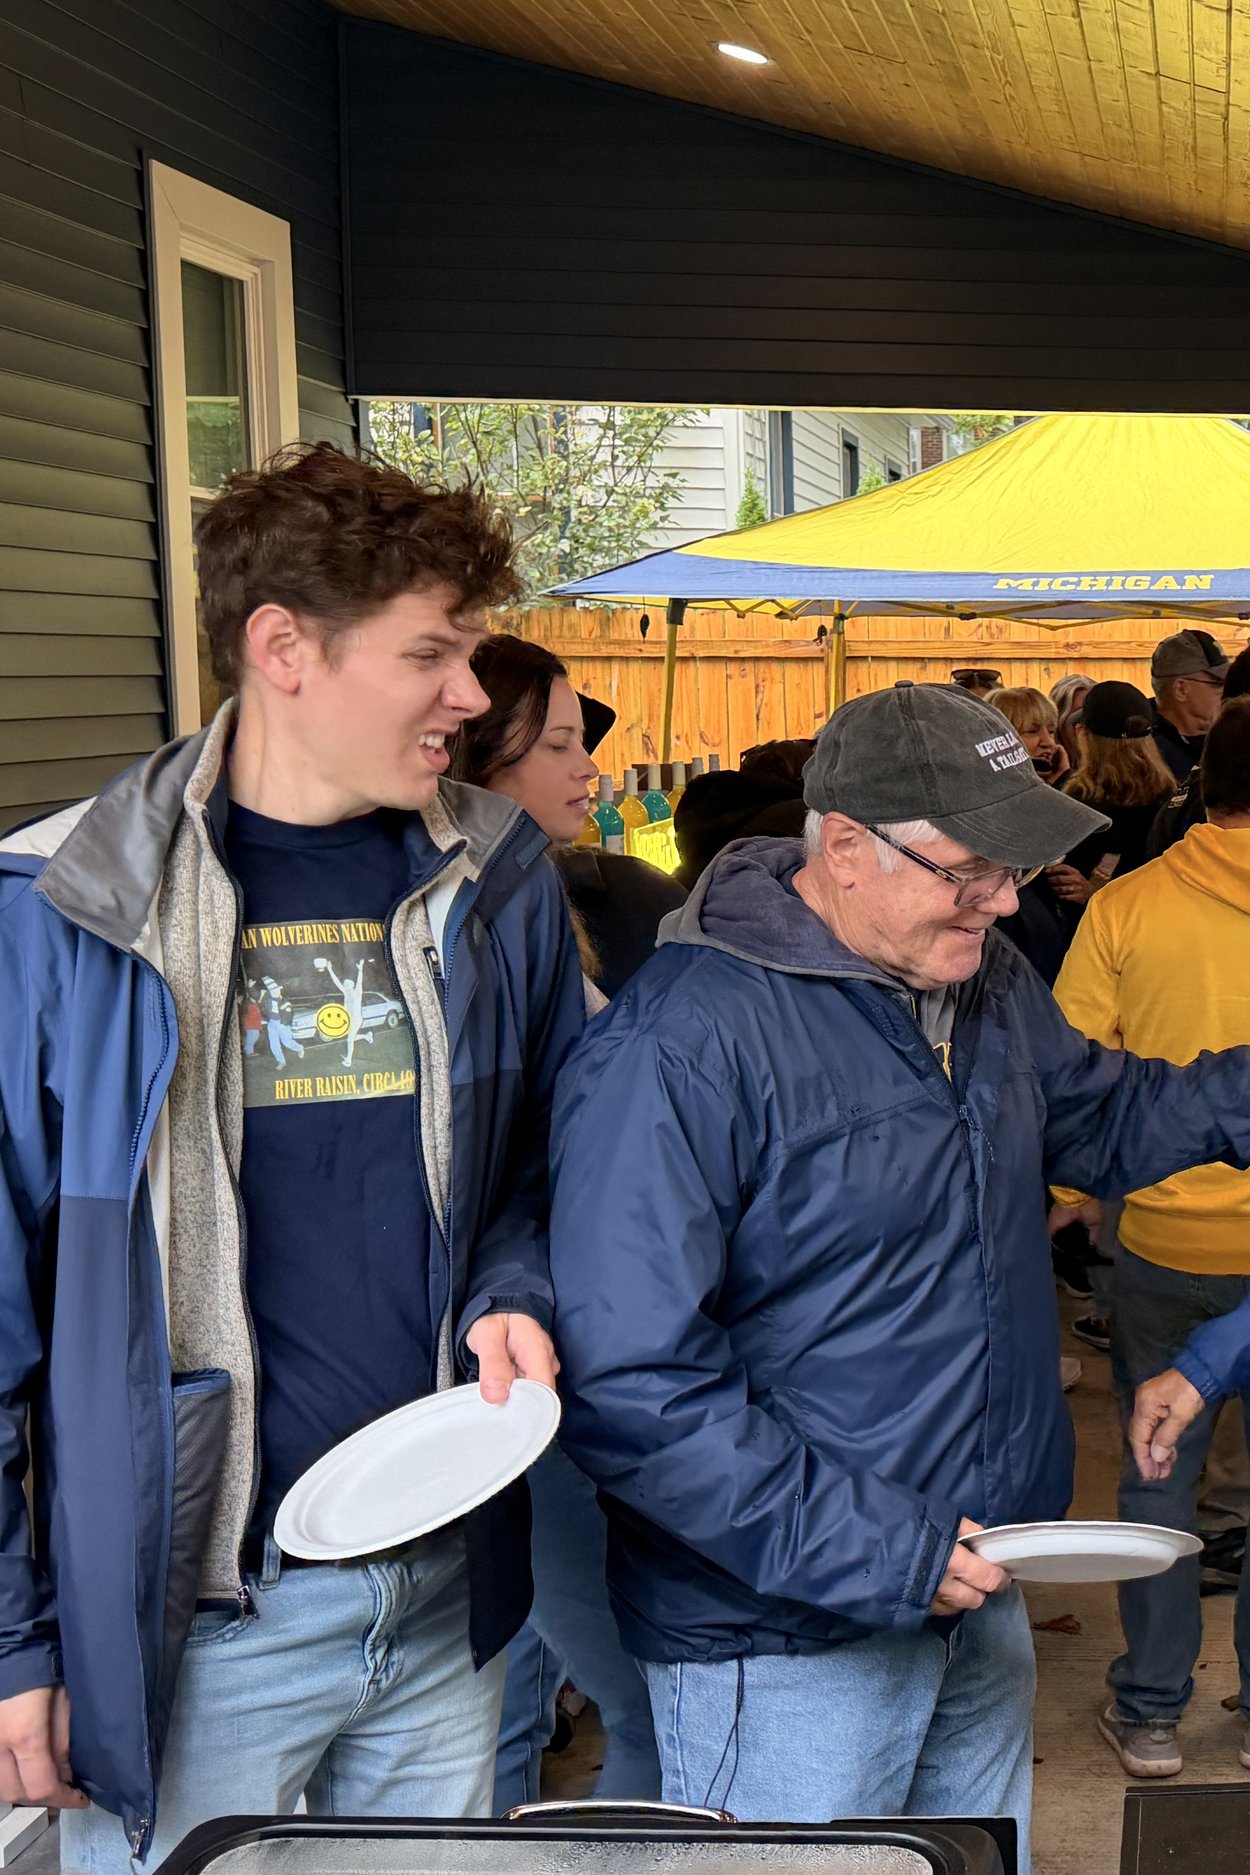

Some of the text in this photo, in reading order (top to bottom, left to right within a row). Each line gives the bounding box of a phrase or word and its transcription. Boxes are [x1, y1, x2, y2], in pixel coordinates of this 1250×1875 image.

[992, 574, 1215, 592] MICHIGAN
[259, 922, 340, 948] WOLVERINES
[341, 922, 386, 943] NATION
[275, 1078, 313, 1100] RIVER
[316, 1074, 360, 1097] RAISIN,
